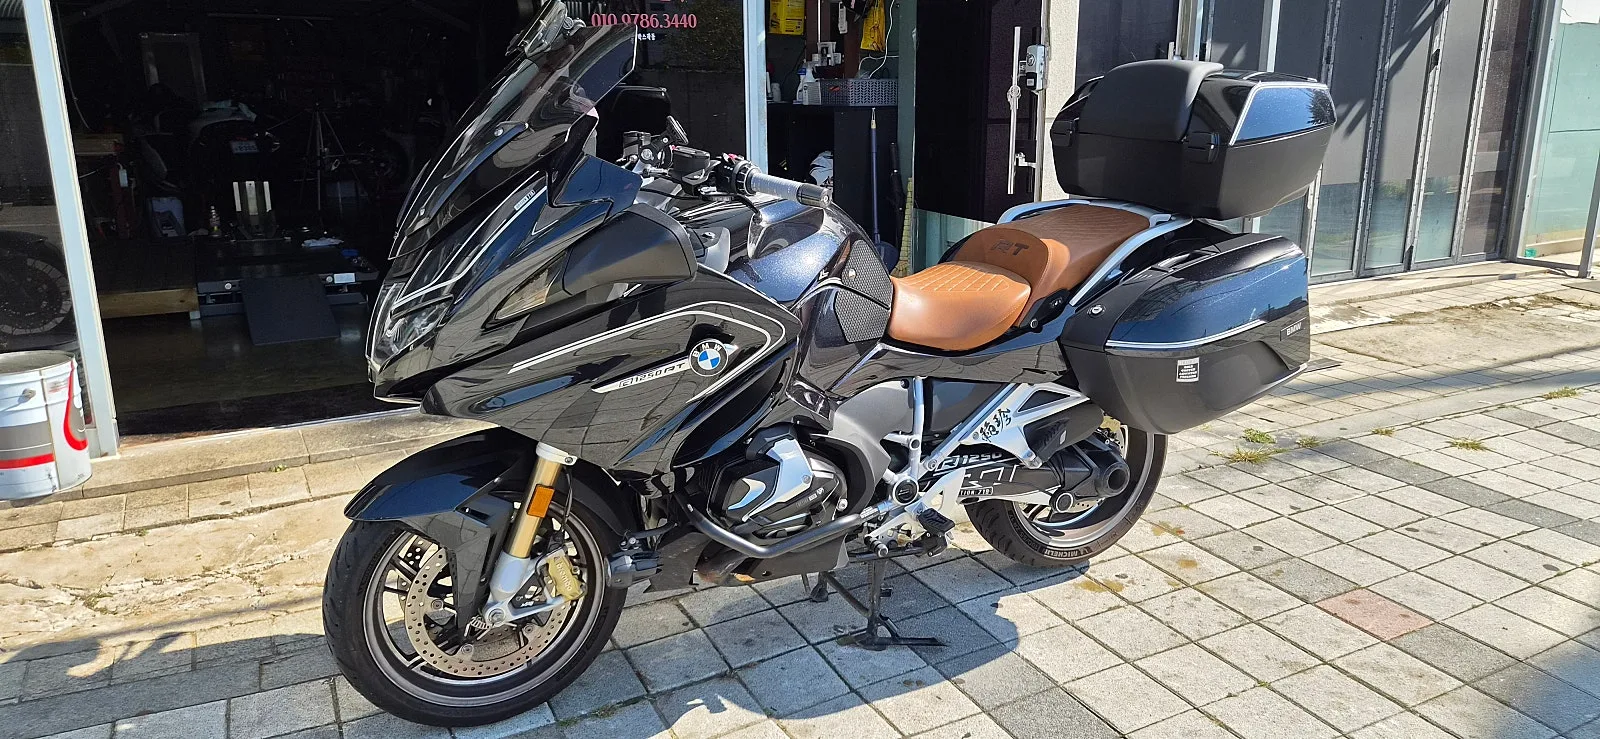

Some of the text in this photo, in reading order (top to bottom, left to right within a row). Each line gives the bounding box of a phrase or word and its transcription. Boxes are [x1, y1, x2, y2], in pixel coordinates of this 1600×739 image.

[591, 13, 697, 28] 0109786.3440
[991, 240, 1029, 255] RT
[1286, 321, 1302, 336] BMW
[692, 342, 722, 358] BMW
